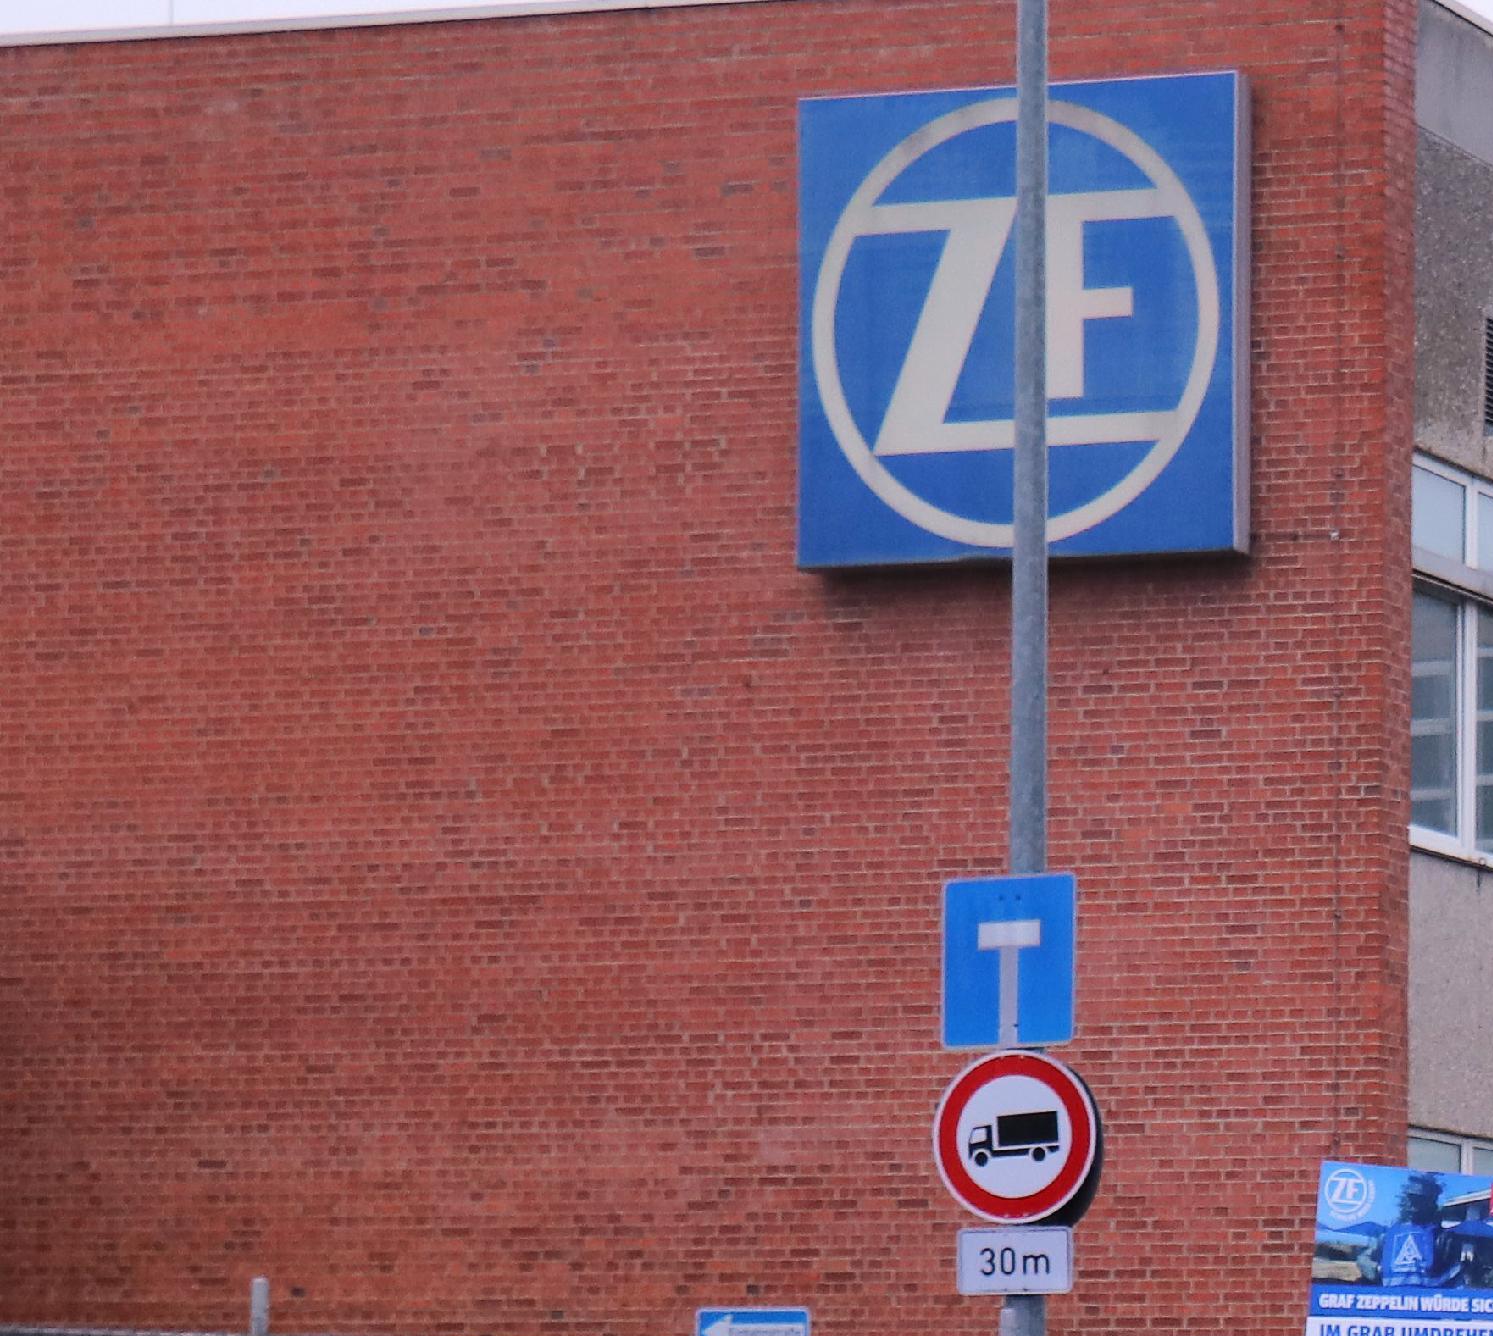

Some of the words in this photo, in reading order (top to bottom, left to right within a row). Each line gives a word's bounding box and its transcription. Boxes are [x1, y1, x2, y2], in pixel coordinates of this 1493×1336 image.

[1319, 1294, 1353, 1309] GRAF
[1356, 1294, 1419, 1312] ZEPPELIN
[1421, 1293, 1470, 1313] WÜRDE
